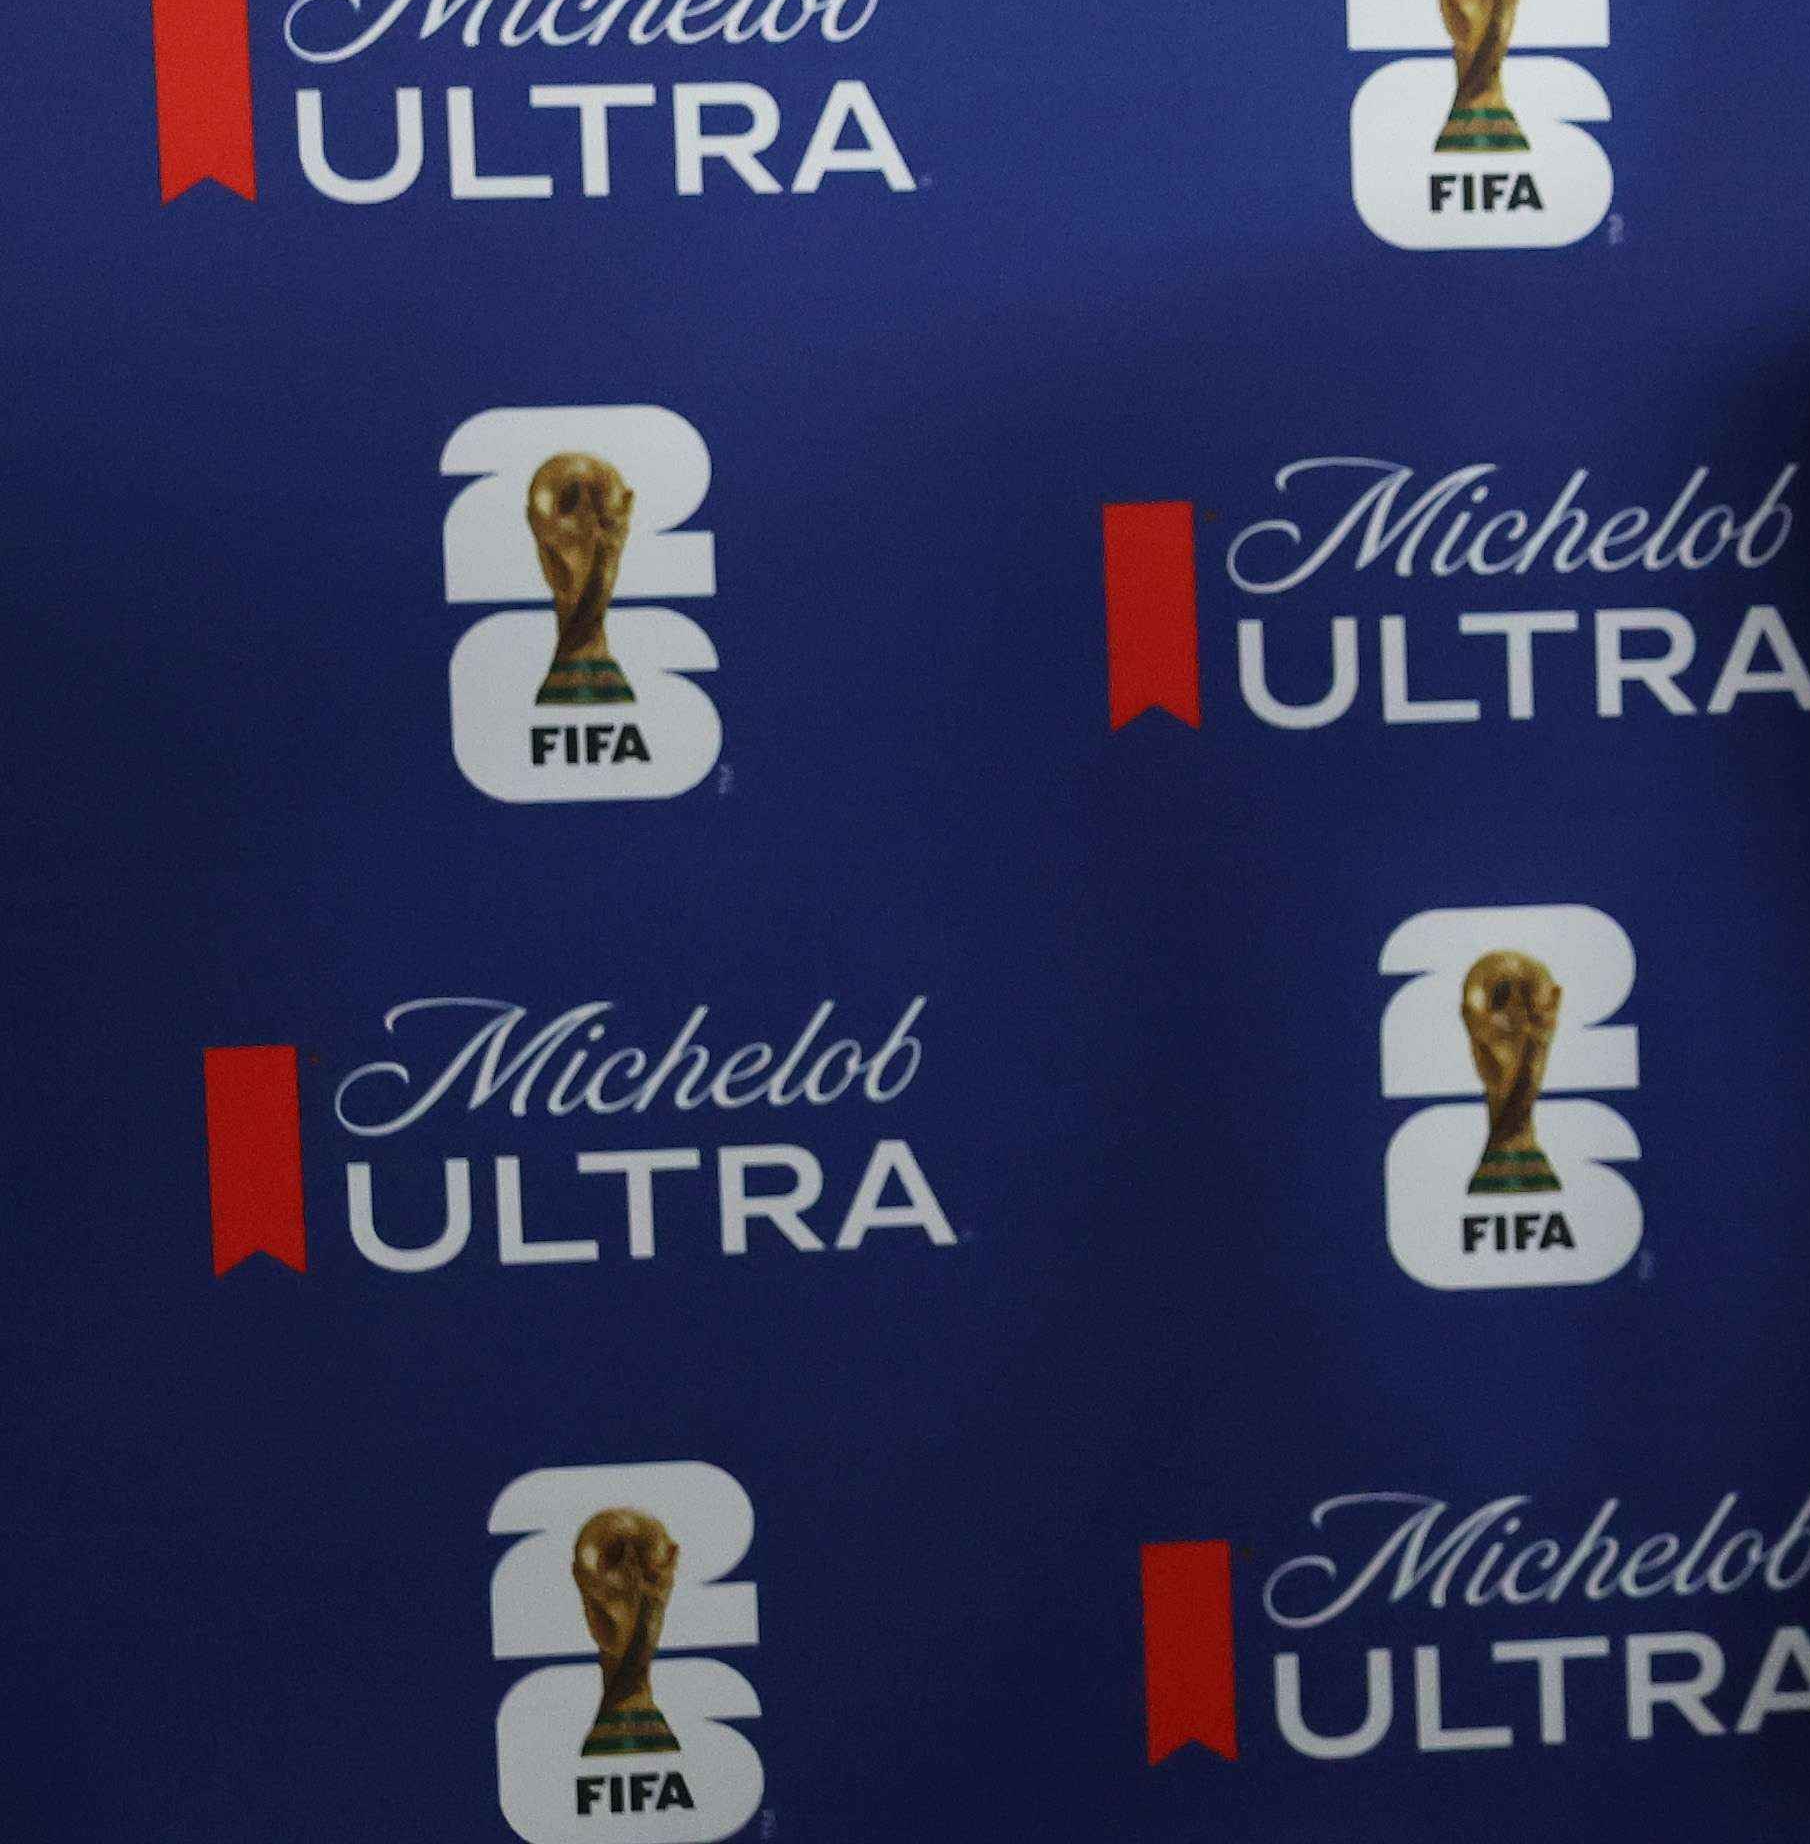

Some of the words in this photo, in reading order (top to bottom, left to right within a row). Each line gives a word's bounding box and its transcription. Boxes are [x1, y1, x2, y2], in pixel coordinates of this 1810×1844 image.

[295, 79, 917, 205] ULTRA
[1429, 173, 1544, 213] FIFA
[1226, 457, 1797, 595] Michelob
[530, 723, 651, 766] FIFA
[334, 995, 927, 1137] Michelob
[346, 1138, 958, 1273] ULTRA
[1462, 1212, 1576, 1254] FIFA
[575, 1771, 695, 1816] FIFA
